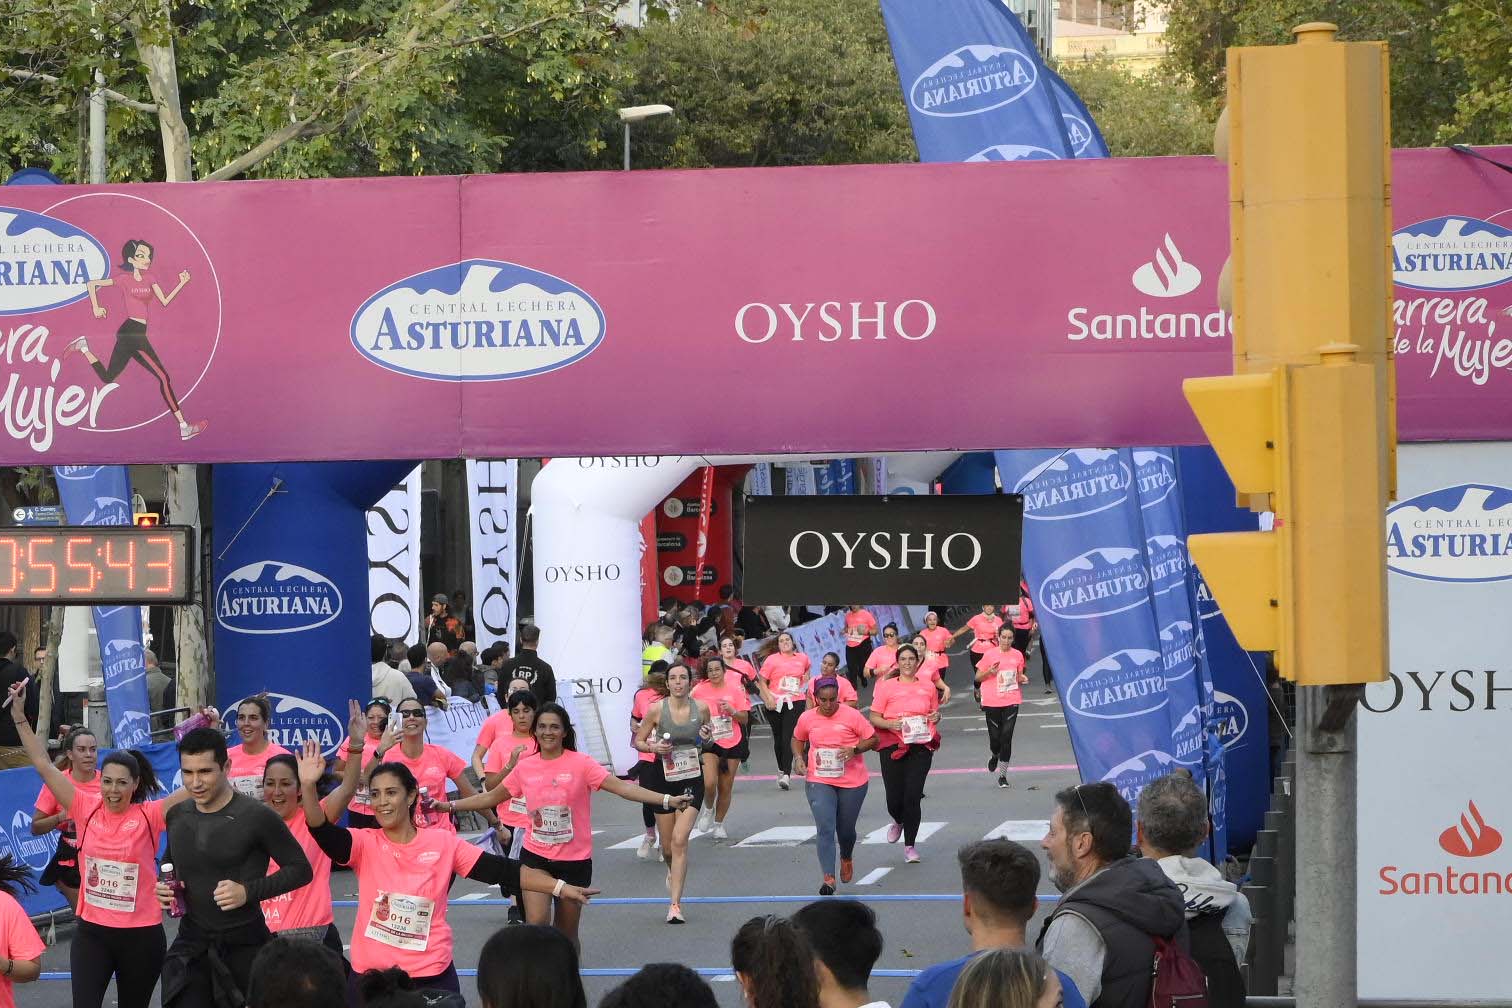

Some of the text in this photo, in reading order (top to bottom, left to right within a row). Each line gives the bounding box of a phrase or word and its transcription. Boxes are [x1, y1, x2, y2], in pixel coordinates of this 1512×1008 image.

[12, 242, 85, 254] LECHERA
[409, 299, 578, 315] CENTRAL LECHERA
[1392, 296, 1488, 326] arrera
[368, 306, 586, 351] ASTURIANA
[734, 299, 937, 344] OYSHO
[1416, 320, 1512, 386] la Muje
[1413, 518, 1480, 529] CENTRAL
[789, 530, 982, 571] OYSHO
[545, 563, 621, 584] OYSHO
[232, 585, 328, 594] CENTRAL LECHERA
[219, 589, 334, 618] ASTURIANA
[576, 676, 623, 696] SHO
[1359, 669, 1512, 713] OYSH
[279, 716, 329, 726] LECHERA
[267, 727, 334, 747] RIANA
[100, 879, 119, 888] 016
[390, 913, 411, 924] 016
